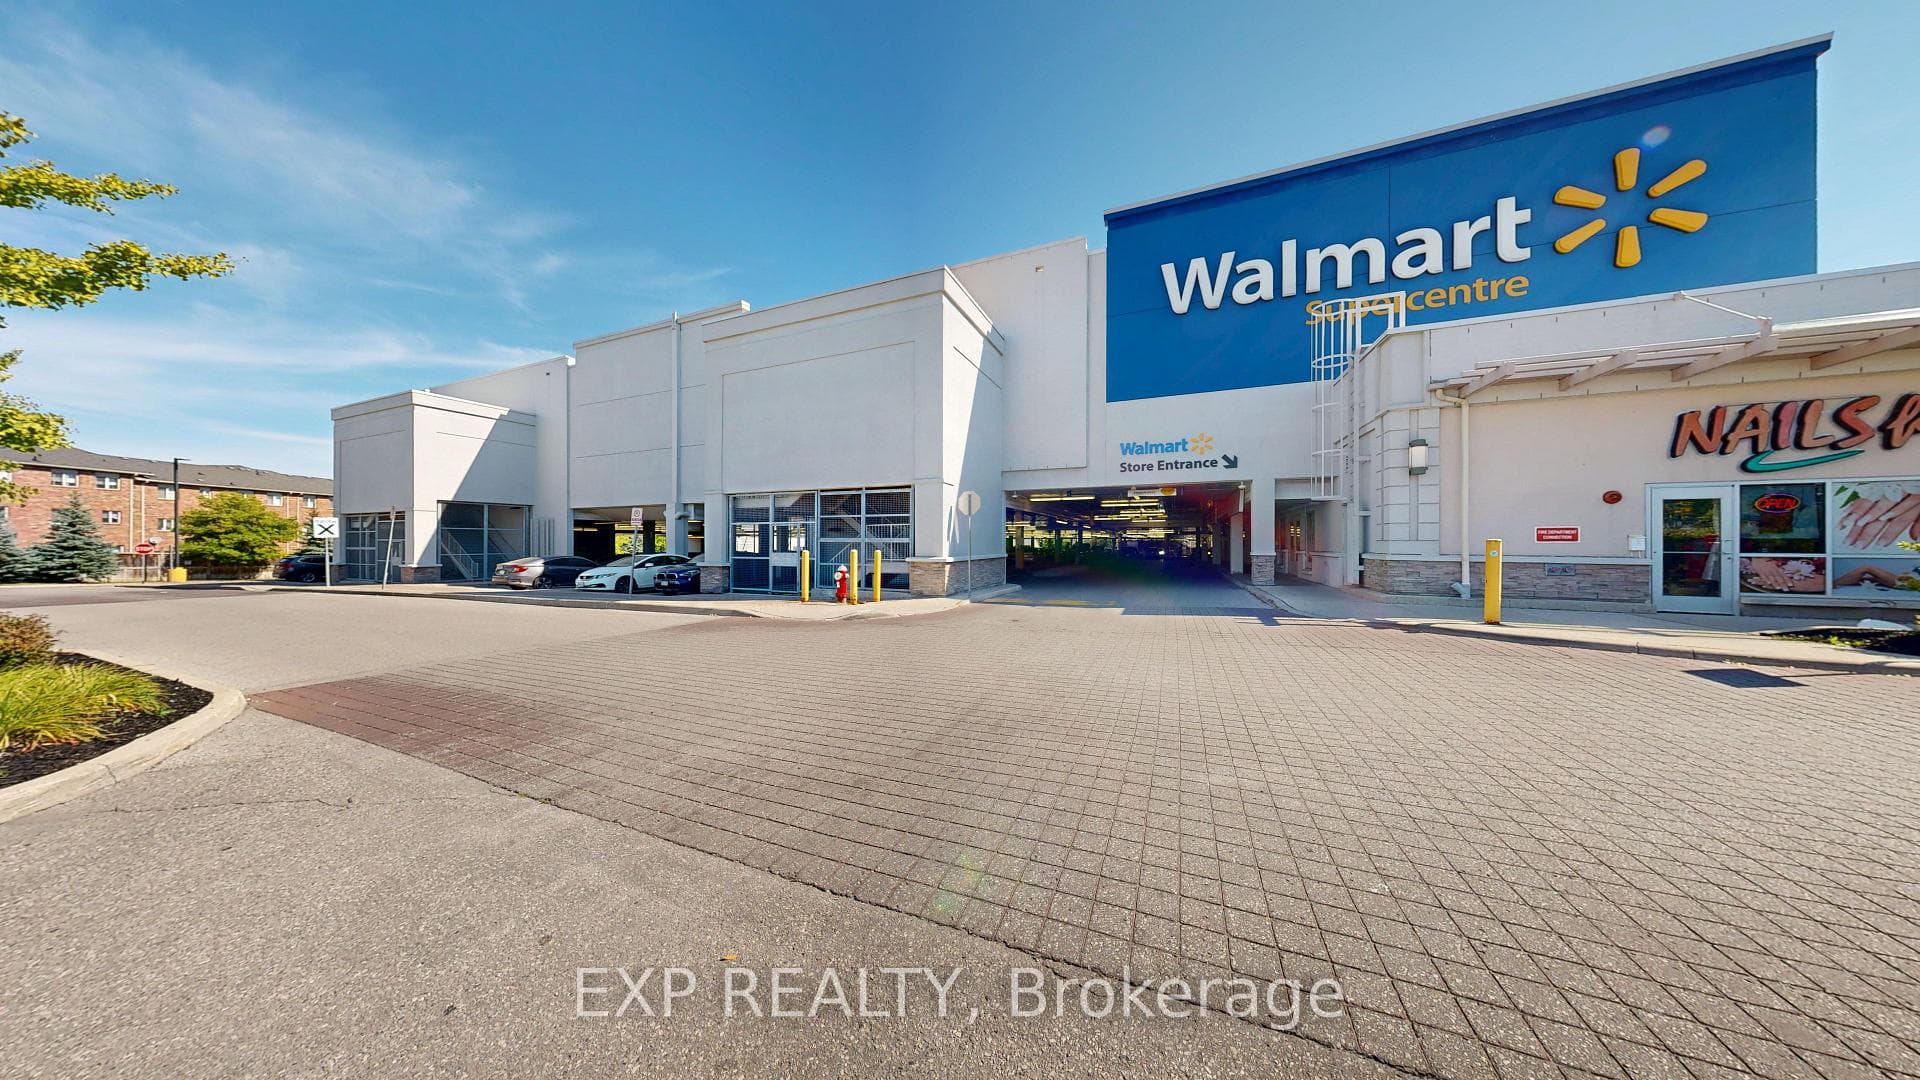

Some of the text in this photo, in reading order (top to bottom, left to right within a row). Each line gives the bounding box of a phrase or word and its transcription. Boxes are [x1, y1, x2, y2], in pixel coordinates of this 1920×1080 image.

[1160, 196, 1532, 315] Walmart
[1669, 394, 1881, 459] NAILS
[1120, 438, 1188, 456] Walmart
[1120, 458, 1218, 473] Store Entrance
[1757, 497, 1798, 509] OPEN
